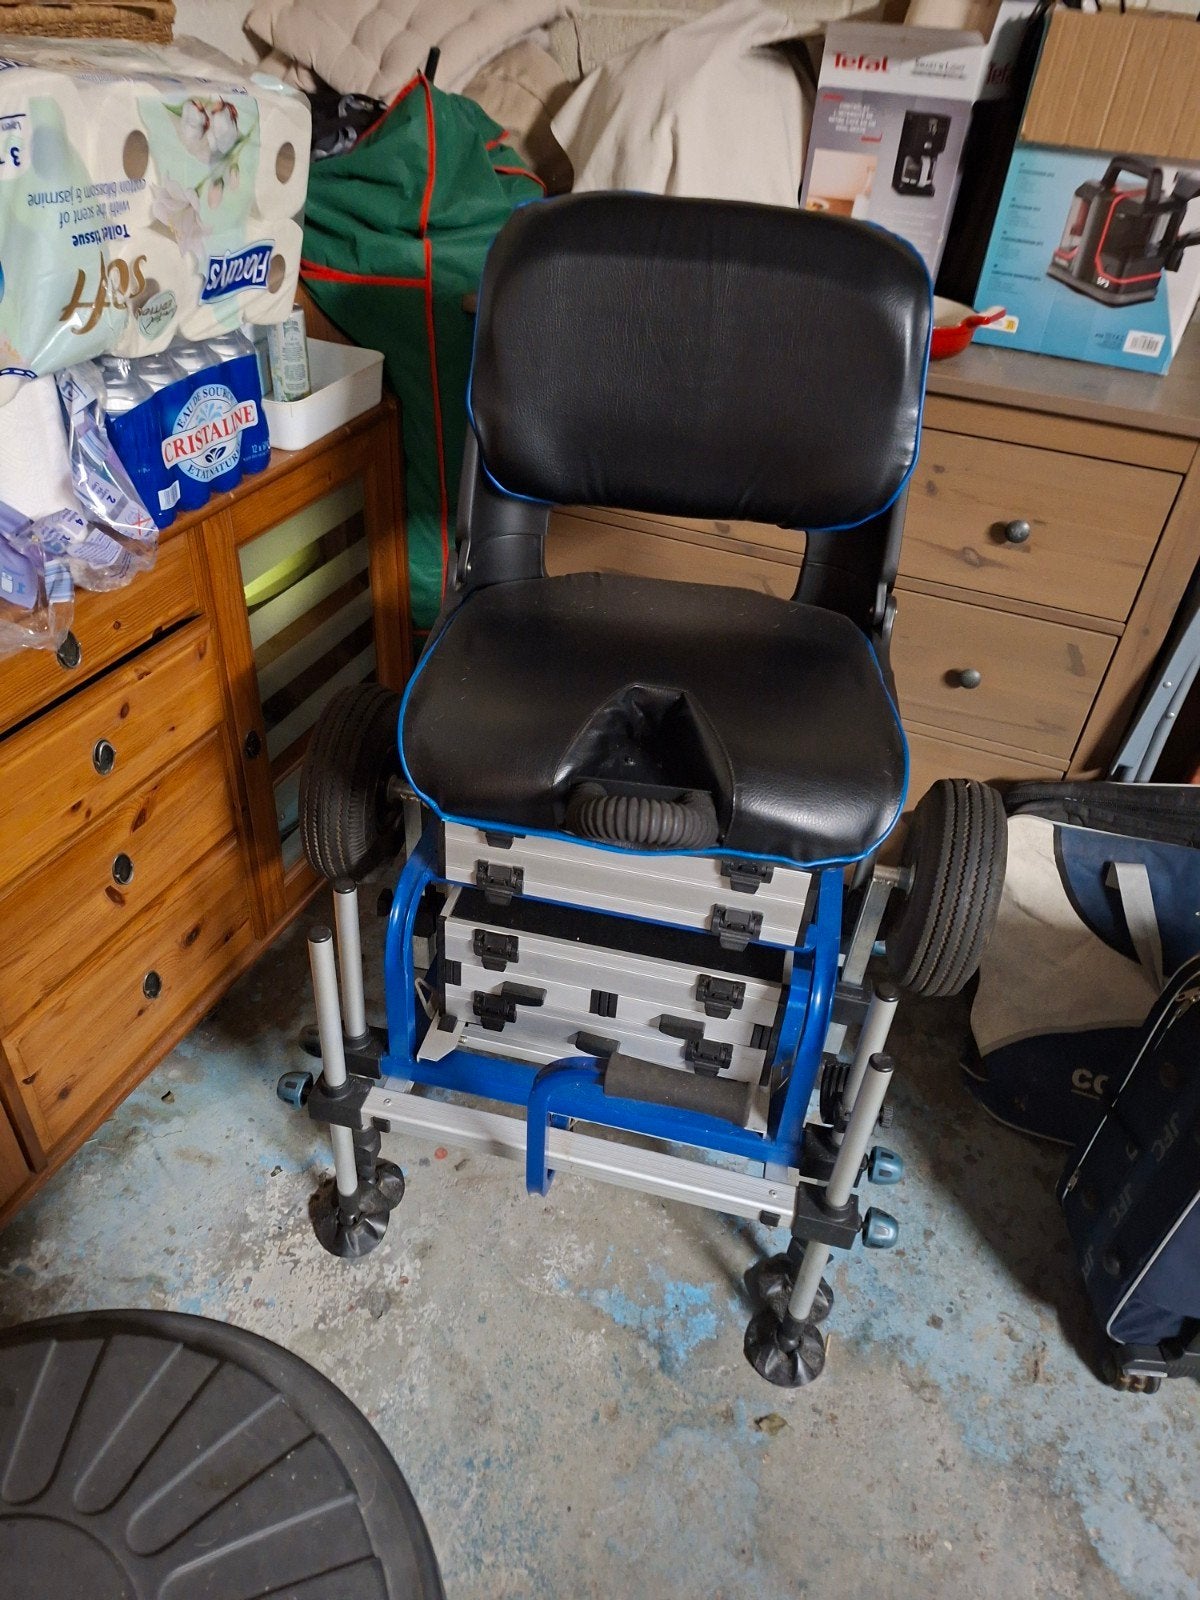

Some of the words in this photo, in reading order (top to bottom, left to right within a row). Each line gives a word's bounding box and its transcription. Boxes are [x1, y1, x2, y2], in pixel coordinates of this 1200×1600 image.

[834, 52, 889, 73] Tefal
[10, 146, 22, 167] 3
[28, 187, 75, 208] jasmine
[59, 211, 71, 229] of
[72, 229, 103, 248] tissue
[59, 250, 147, 335] soft
[177, 403, 194, 429] EAU
[163, 405, 255, 463] CRISTALINE
[75, 518, 84, 526] 4
[1151, 1111, 1180, 1162] JFC
